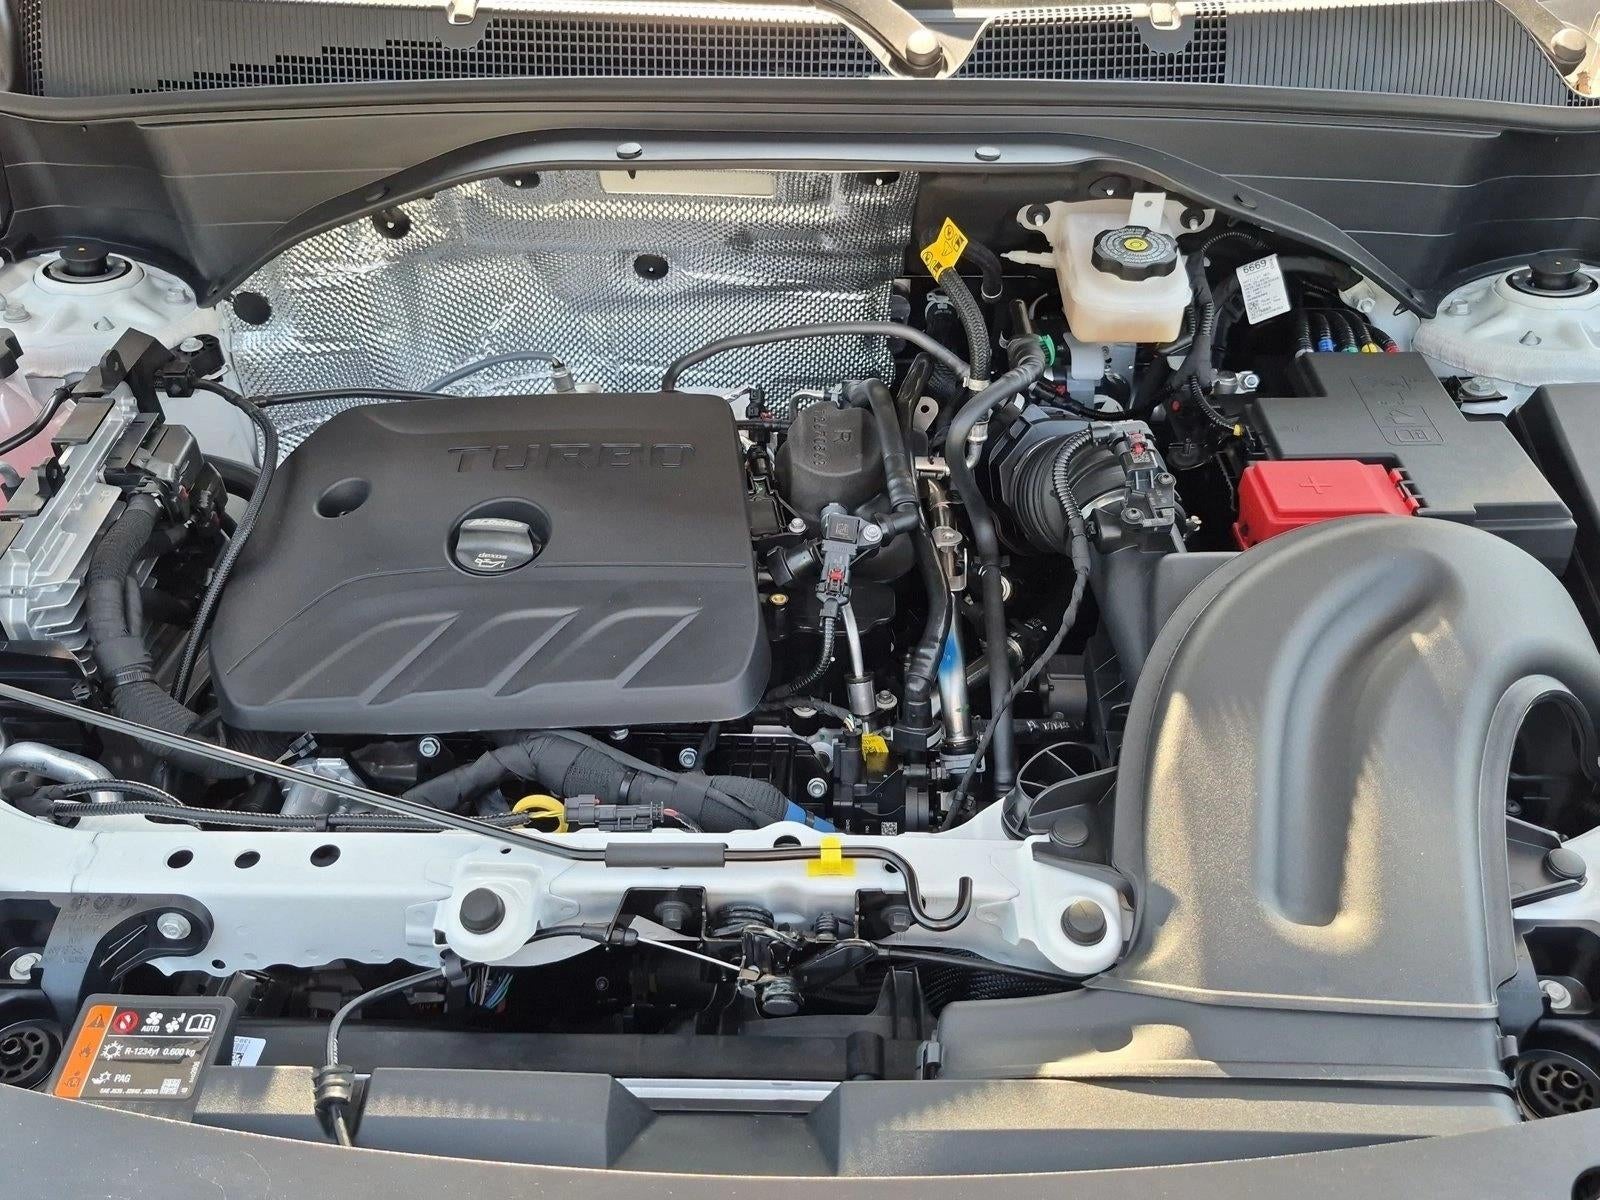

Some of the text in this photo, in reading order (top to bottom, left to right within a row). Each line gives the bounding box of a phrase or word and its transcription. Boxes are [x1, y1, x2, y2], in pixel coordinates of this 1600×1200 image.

[447, 443, 696, 473] TURBO
[478, 552, 508, 560] dexos
[185, 1048, 196, 1058] kg
[114, 1073, 131, 1084] PAG
